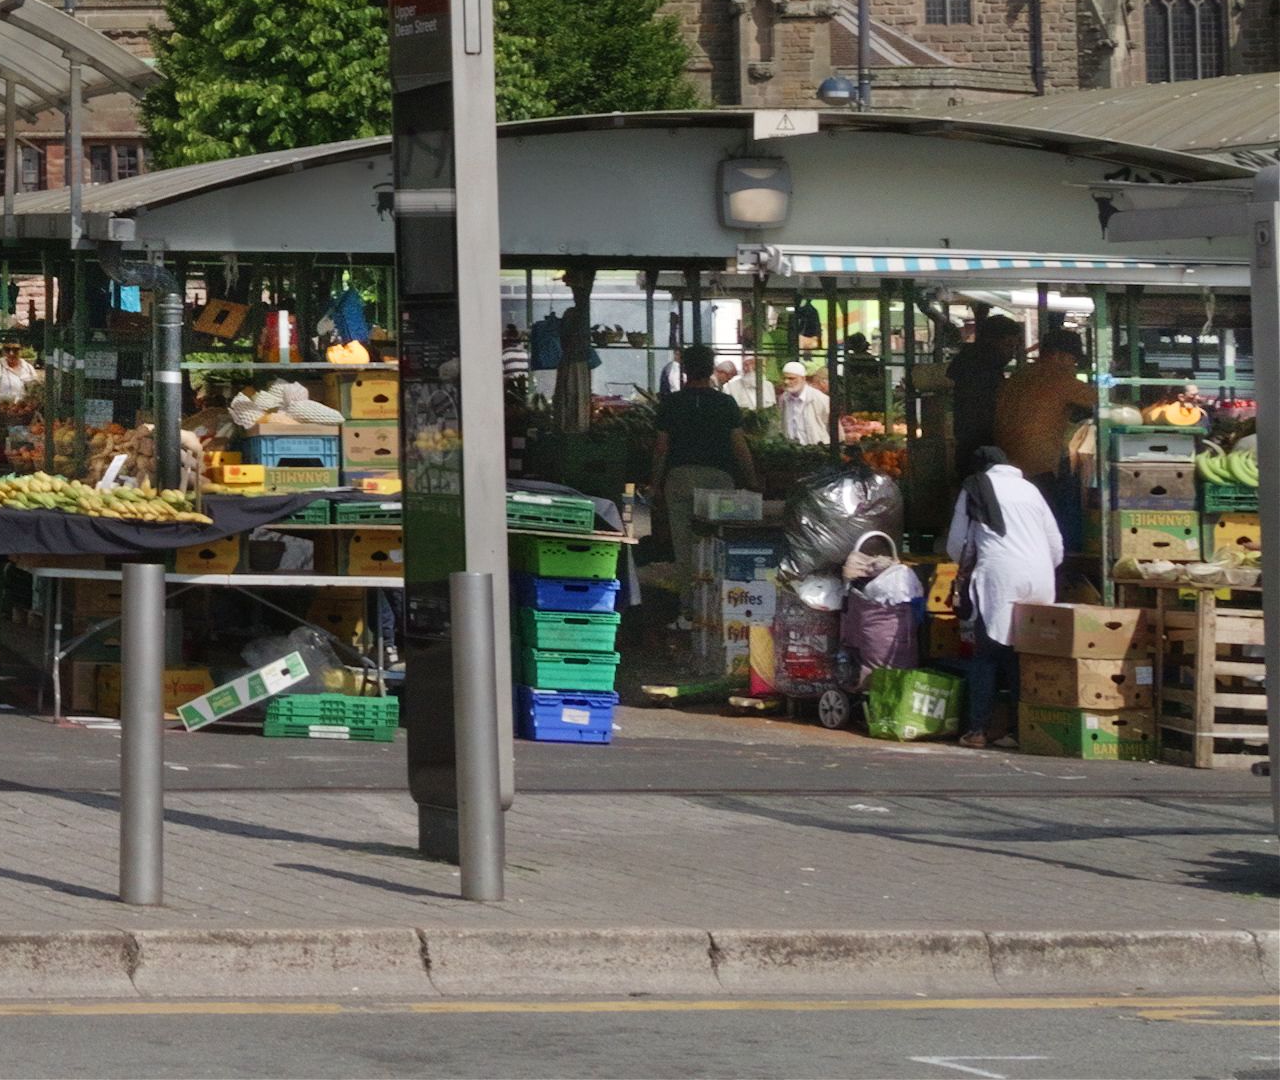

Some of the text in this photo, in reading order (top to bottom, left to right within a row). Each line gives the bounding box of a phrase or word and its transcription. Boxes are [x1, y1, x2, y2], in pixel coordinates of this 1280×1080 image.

[395, 5, 416, 20] Upper
[395, 18, 437, 36] Dean Street
[269, 470, 330, 483] BANAMIEL
[1128, 513, 1191, 527] BANAMIEL
[912, 692, 946, 719] TEA
